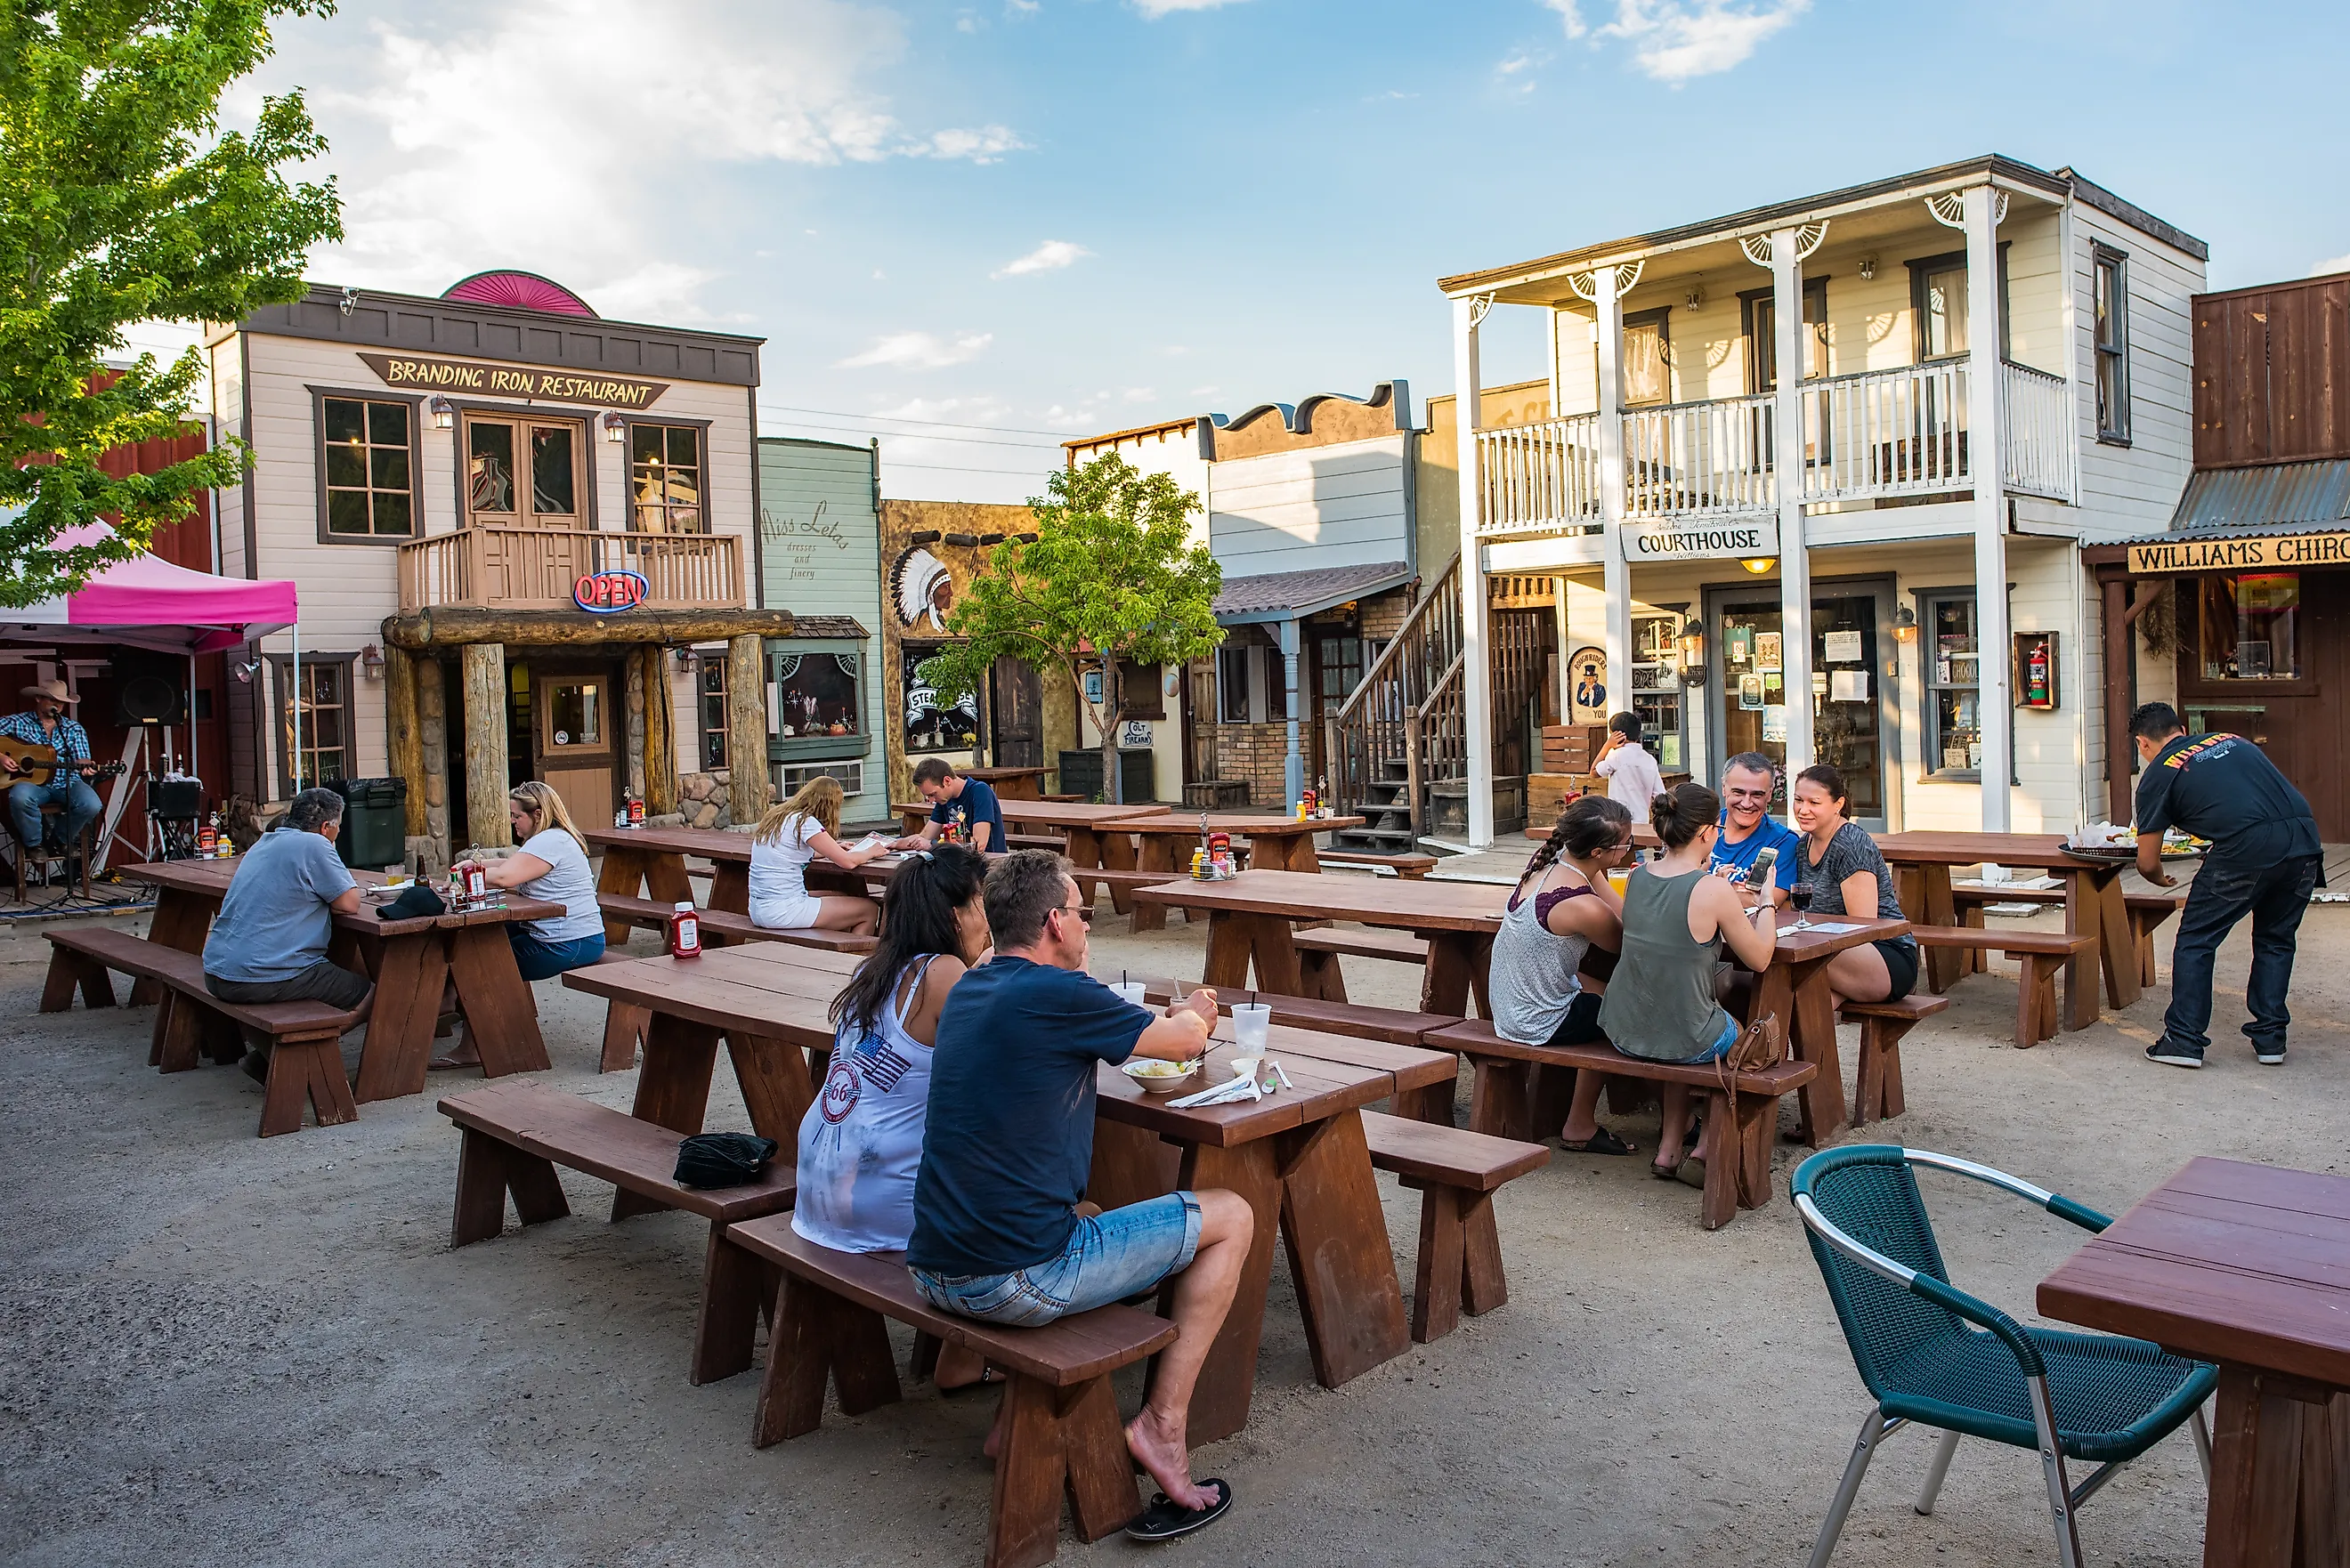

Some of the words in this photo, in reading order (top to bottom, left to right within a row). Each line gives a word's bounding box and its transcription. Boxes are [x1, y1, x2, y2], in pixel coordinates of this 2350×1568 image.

[387, 360, 483, 388] BRANDING
[490, 370, 534, 394] IRON
[539, 375, 652, 405] RESTAURANT
[787, 542, 816, 552] dresses
[1638, 529, 1761, 554] COURTHOUSE
[794, 554, 811, 563] and
[2136, 541, 2264, 570] WILLIAMS
[789, 567, 815, 580] finery
[576, 575, 642, 605] OPEN
[1574, 654, 1589, 671] ROUGH
[1592, 710, 1607, 718] YOU
[1129, 720, 1146, 736] COLT
[1124, 731, 1152, 745] FIREARMS
[2163, 744, 2205, 770] WILD
[831, 1081, 848, 1102] 66
